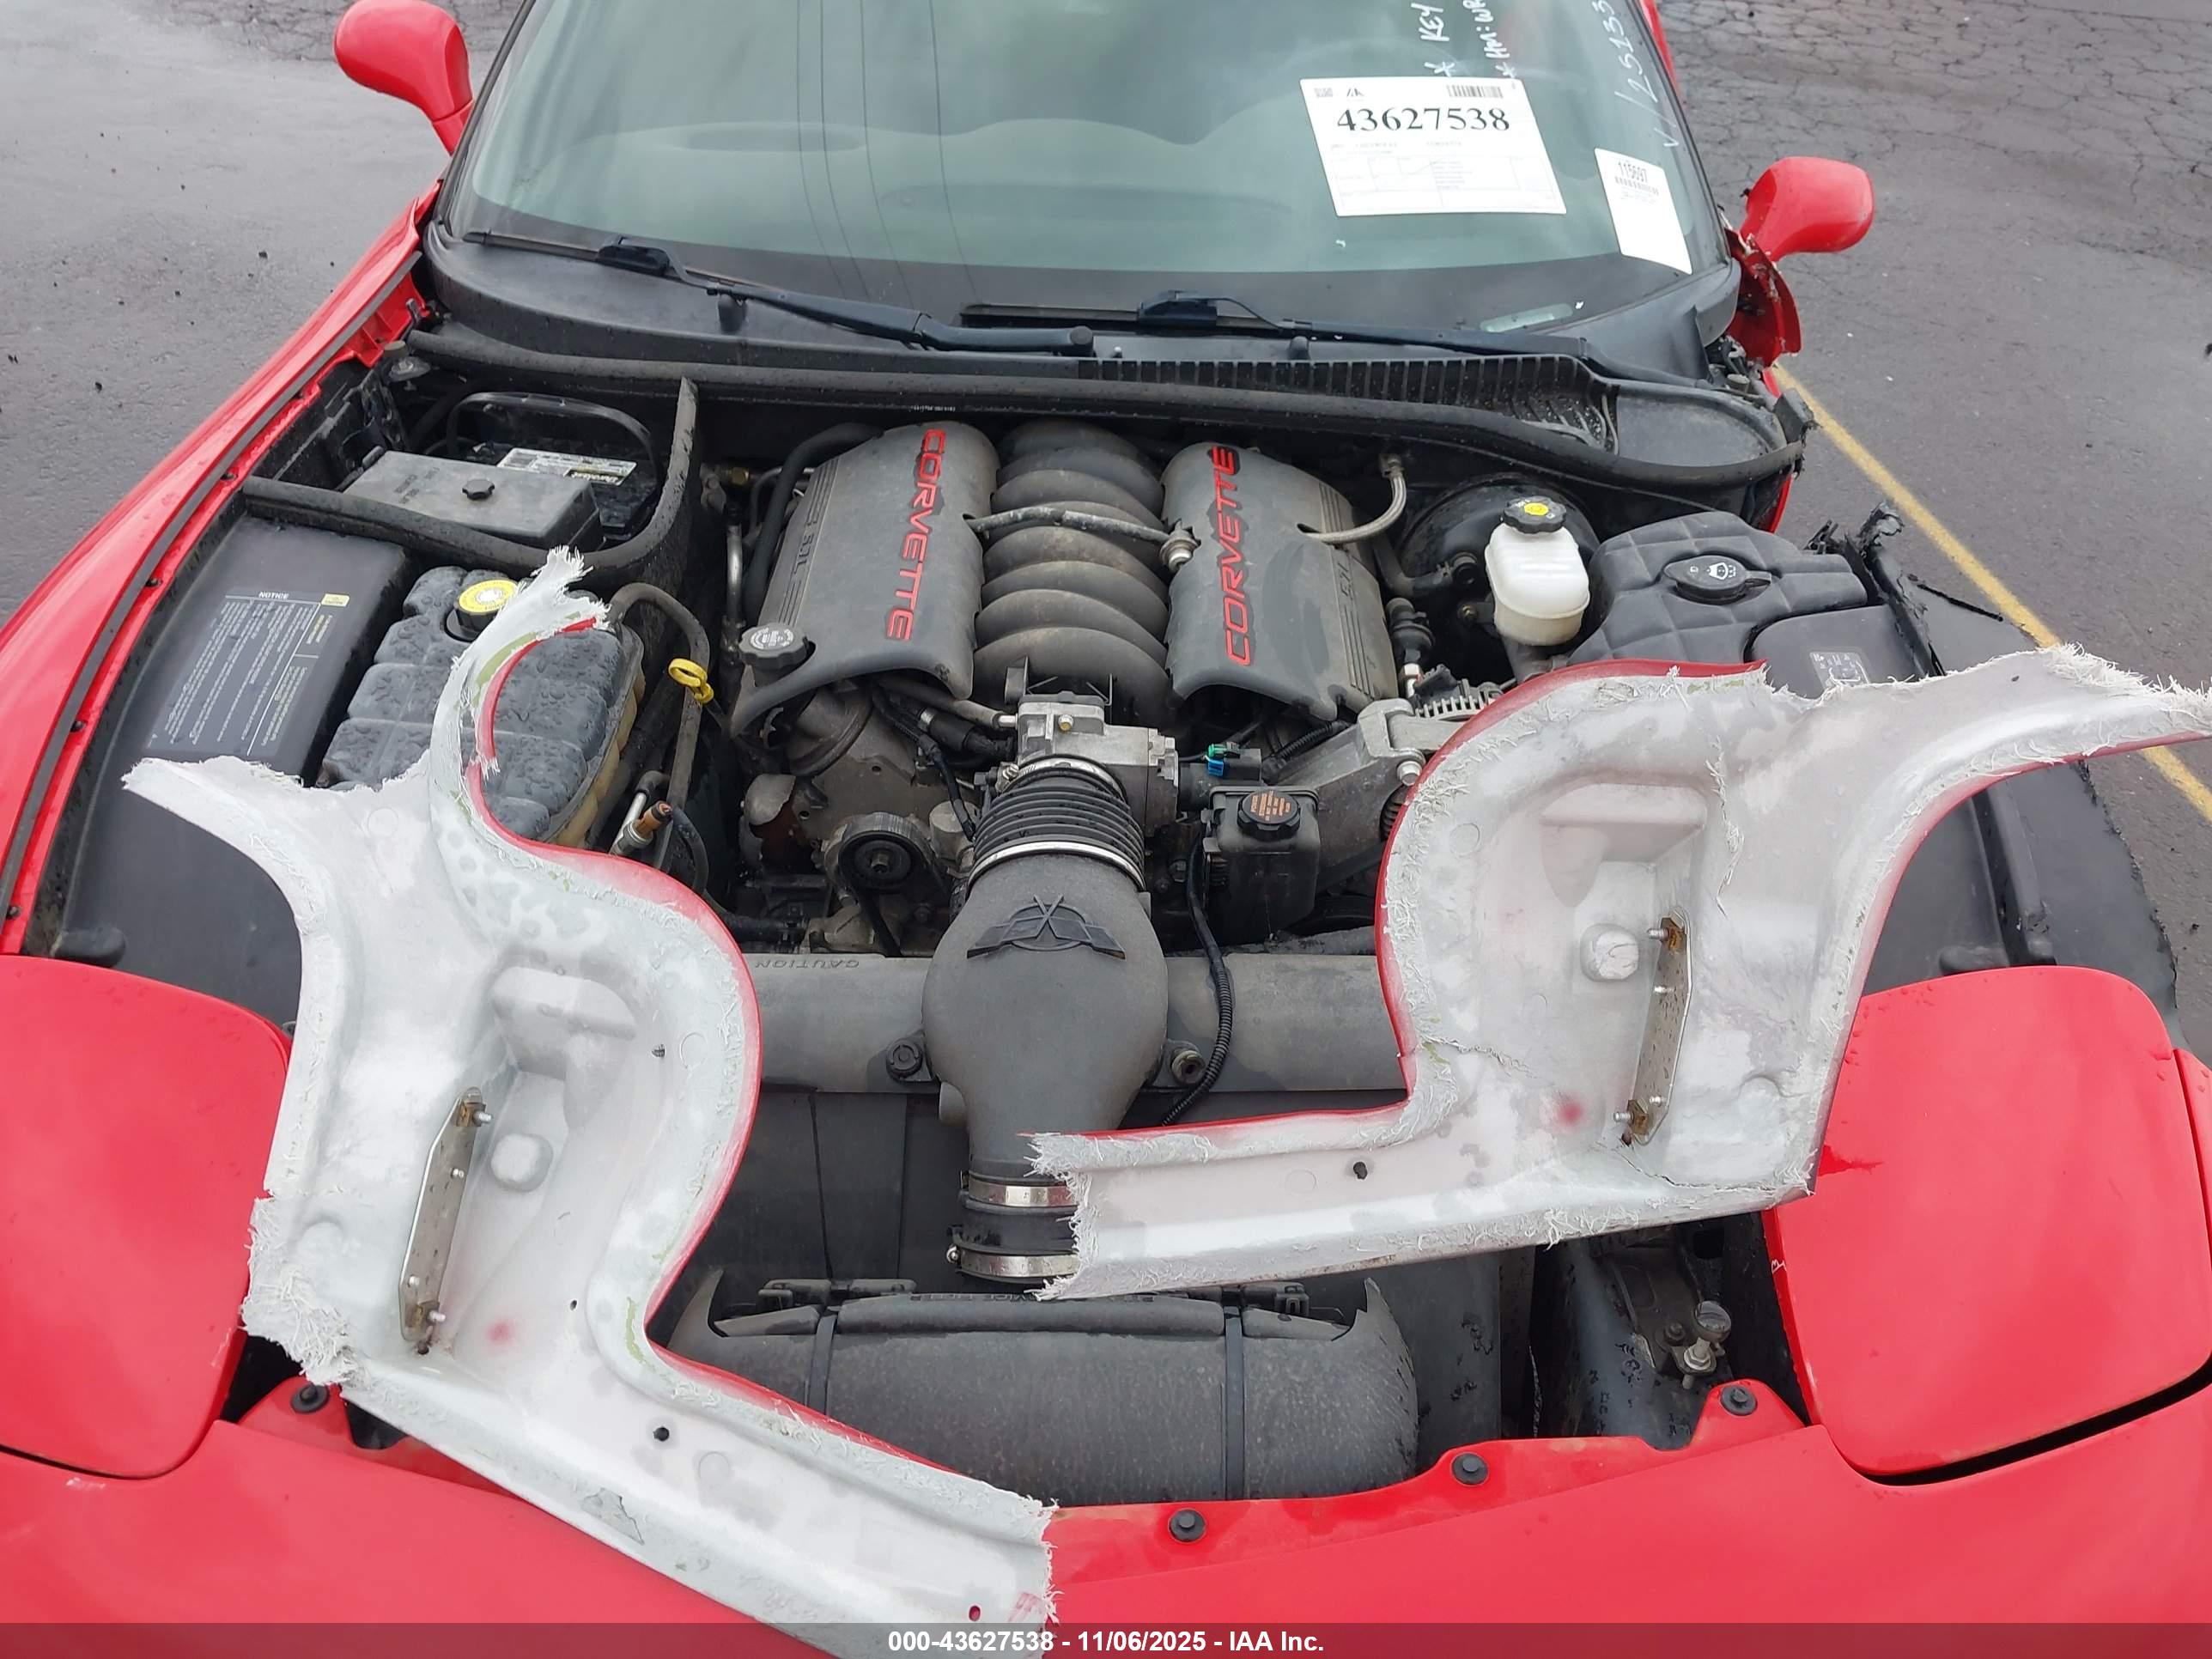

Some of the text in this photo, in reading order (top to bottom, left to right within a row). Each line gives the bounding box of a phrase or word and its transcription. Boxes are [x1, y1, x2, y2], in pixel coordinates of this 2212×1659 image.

[1411, 2, 1450, 42] KEY
[1337, 107, 1510, 131] 43627538
[886, 427, 946, 642] CORVETTE
[1211, 445, 1252, 667] CORVETTE
[258, 591, 290, 599] NOTICE
[754, 959, 860, 969] CAUTION
